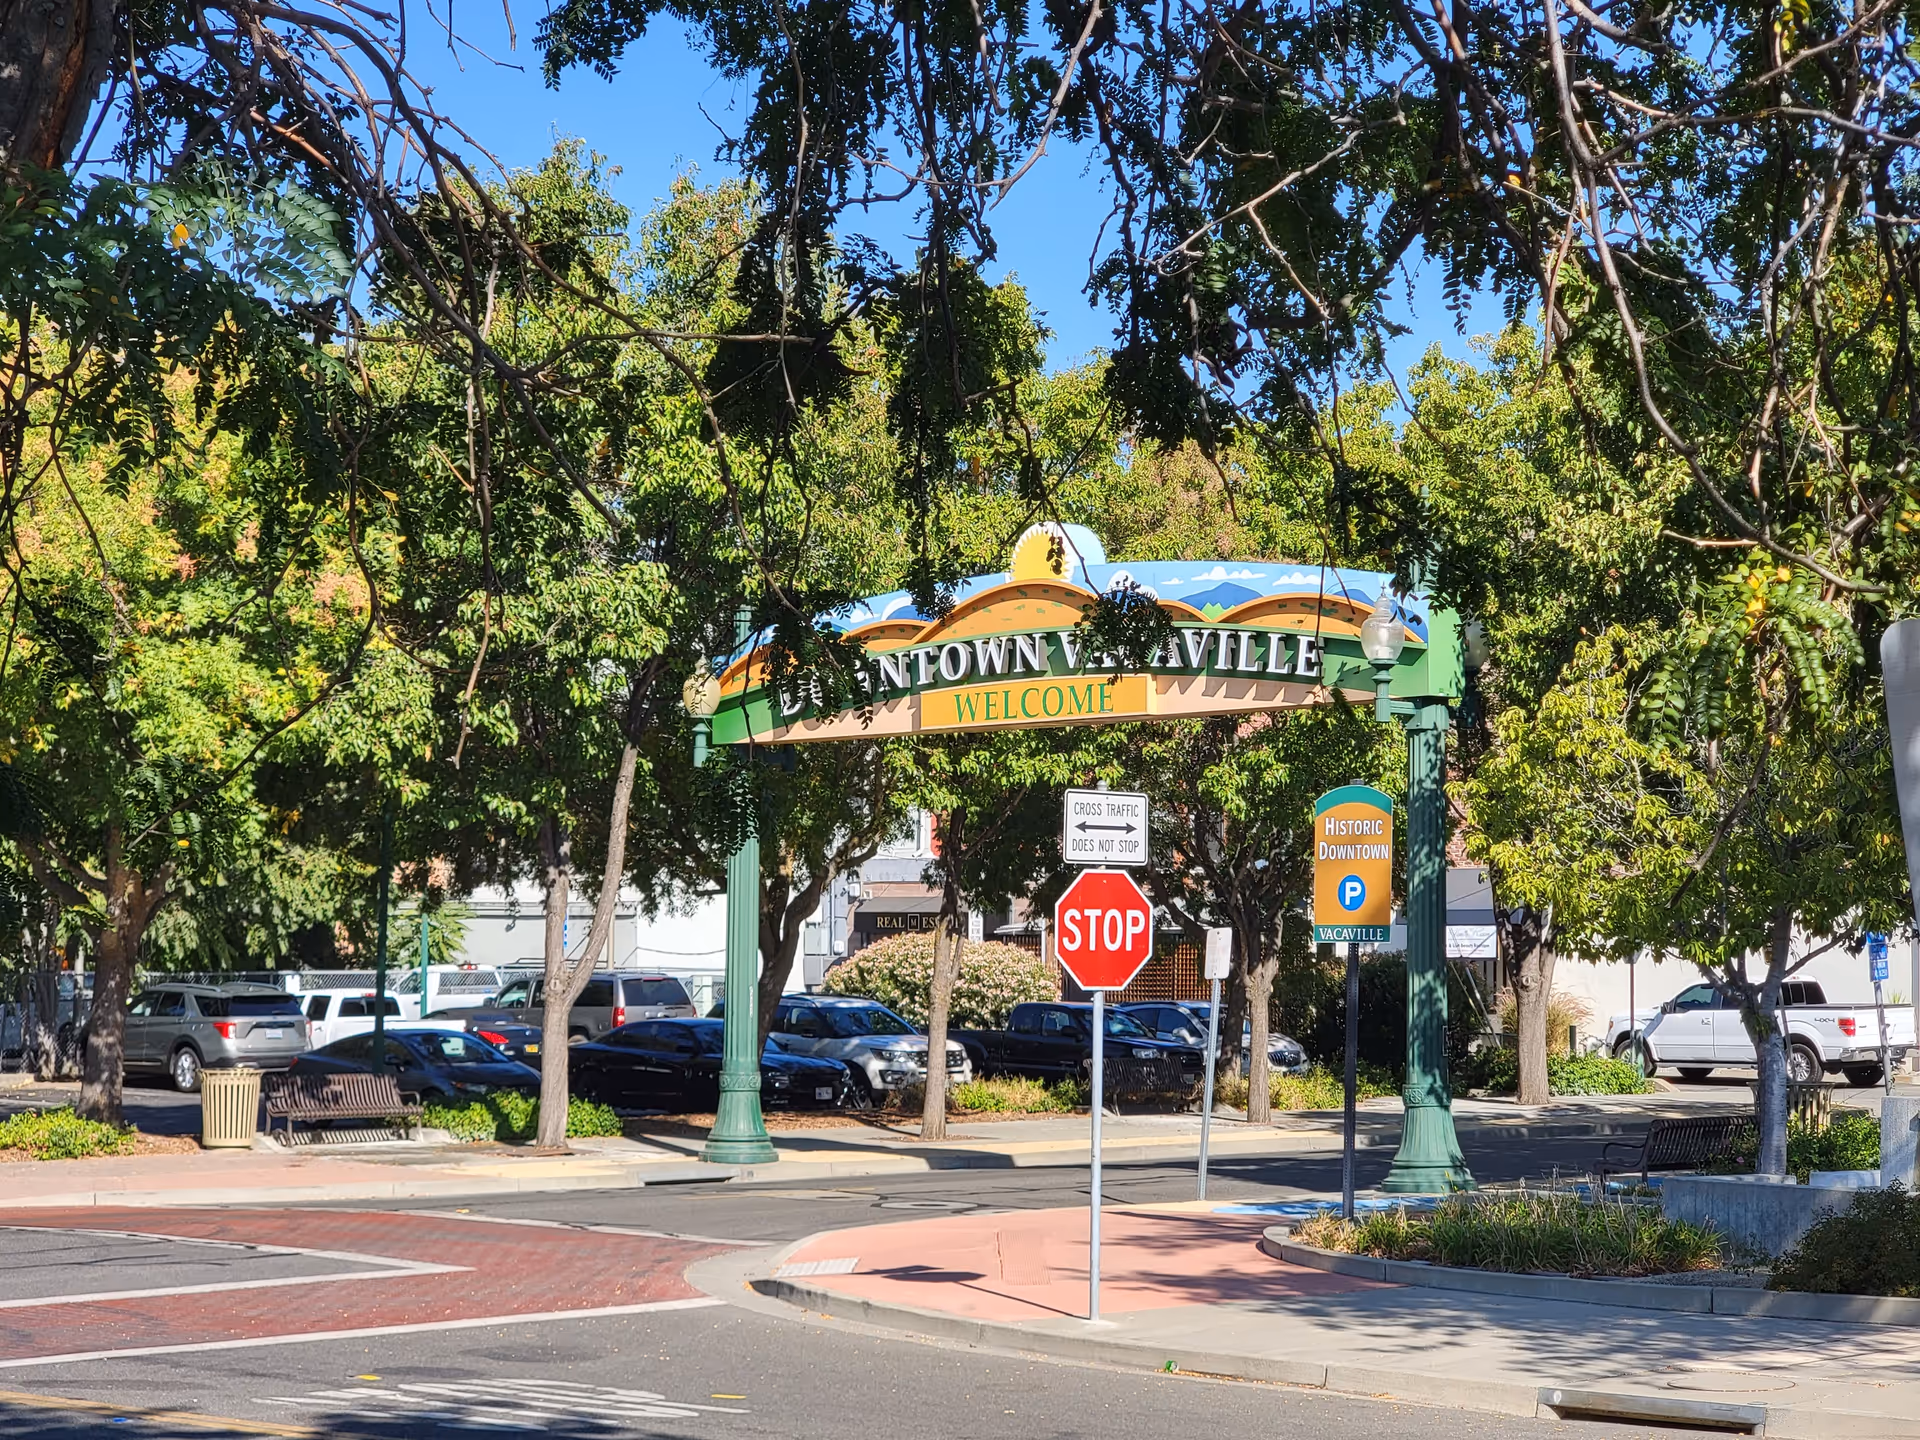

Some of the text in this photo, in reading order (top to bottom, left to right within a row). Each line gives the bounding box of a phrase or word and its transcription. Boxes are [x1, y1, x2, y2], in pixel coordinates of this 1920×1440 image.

[779, 628, 1323, 717] DNTOWN VAVILLE
[954, 683, 1114, 723] WELCOME
[1074, 802, 1139, 818] CROSS TRAFFIC
[1072, 838, 1140, 854] DOES NOT STOP
[1345, 881, 1362, 906] P
[876, 916, 905, 929] REAL
[1062, 908, 1146, 951] STOP
[1319, 927, 1384, 941] VACAVILLE
